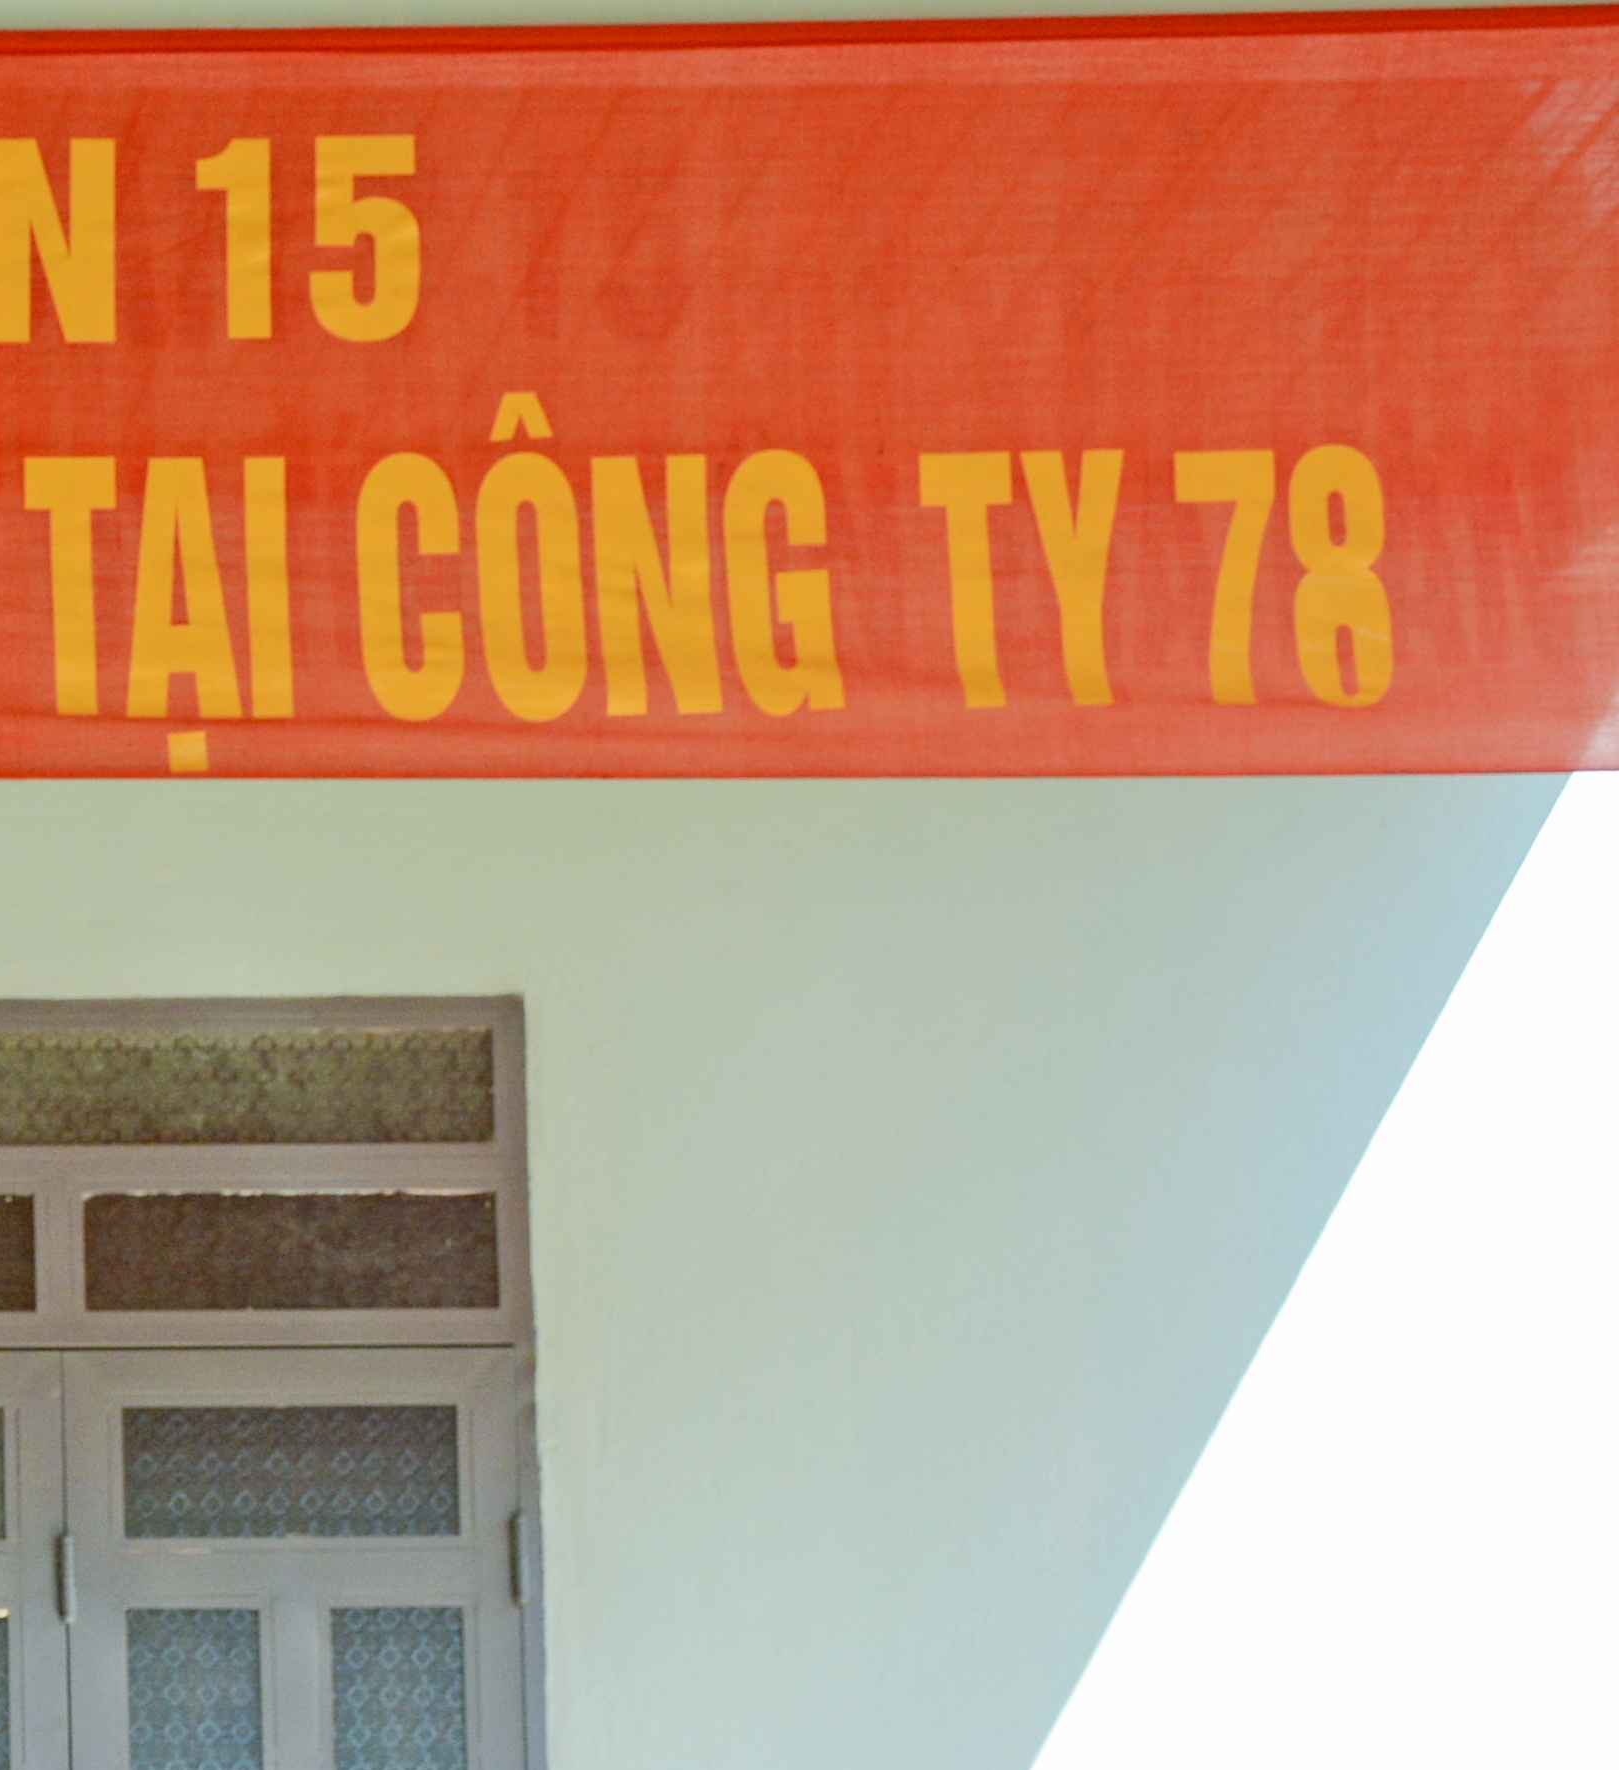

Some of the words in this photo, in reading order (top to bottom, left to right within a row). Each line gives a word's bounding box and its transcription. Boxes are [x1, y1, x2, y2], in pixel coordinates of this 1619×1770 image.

[196, 135, 420, 342] 15
[24, 456, 295, 774] TẠI
[356, 391, 846, 724] CÔNG
[919, 448, 1124, 709] TY
[1174, 443, 1395, 707] 78
